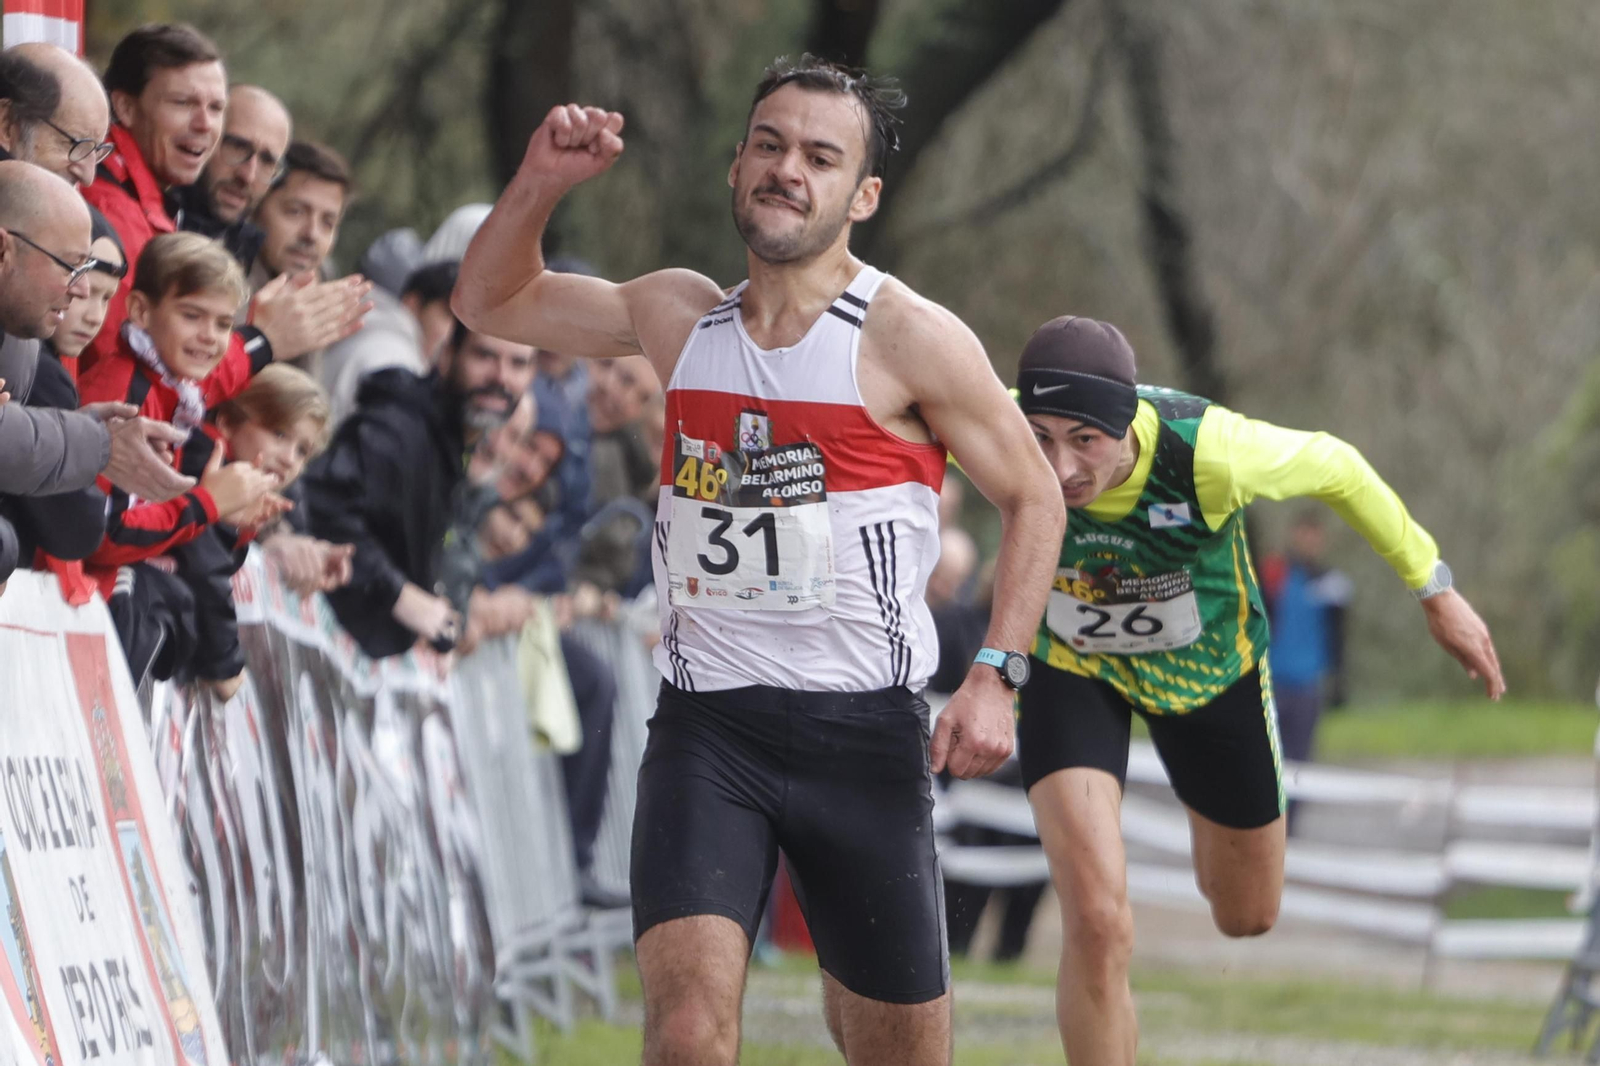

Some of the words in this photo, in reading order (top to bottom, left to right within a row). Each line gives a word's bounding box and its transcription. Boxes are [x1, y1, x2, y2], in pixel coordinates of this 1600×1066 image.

[752, 446, 822, 471] MEMORIAL
[741, 462, 824, 485] BELARMINO
[762, 479, 822, 498] ALONSO
[697, 506, 779, 576] 31
[1073, 533, 1134, 549] LUCUS
[1116, 576, 1190, 595] BELARMINO
[1121, 569, 1190, 587] MEMORIAL
[1139, 583, 1189, 600] ALONSO
[1076, 604, 1163, 637] 26
[68, 874, 95, 922] DE
